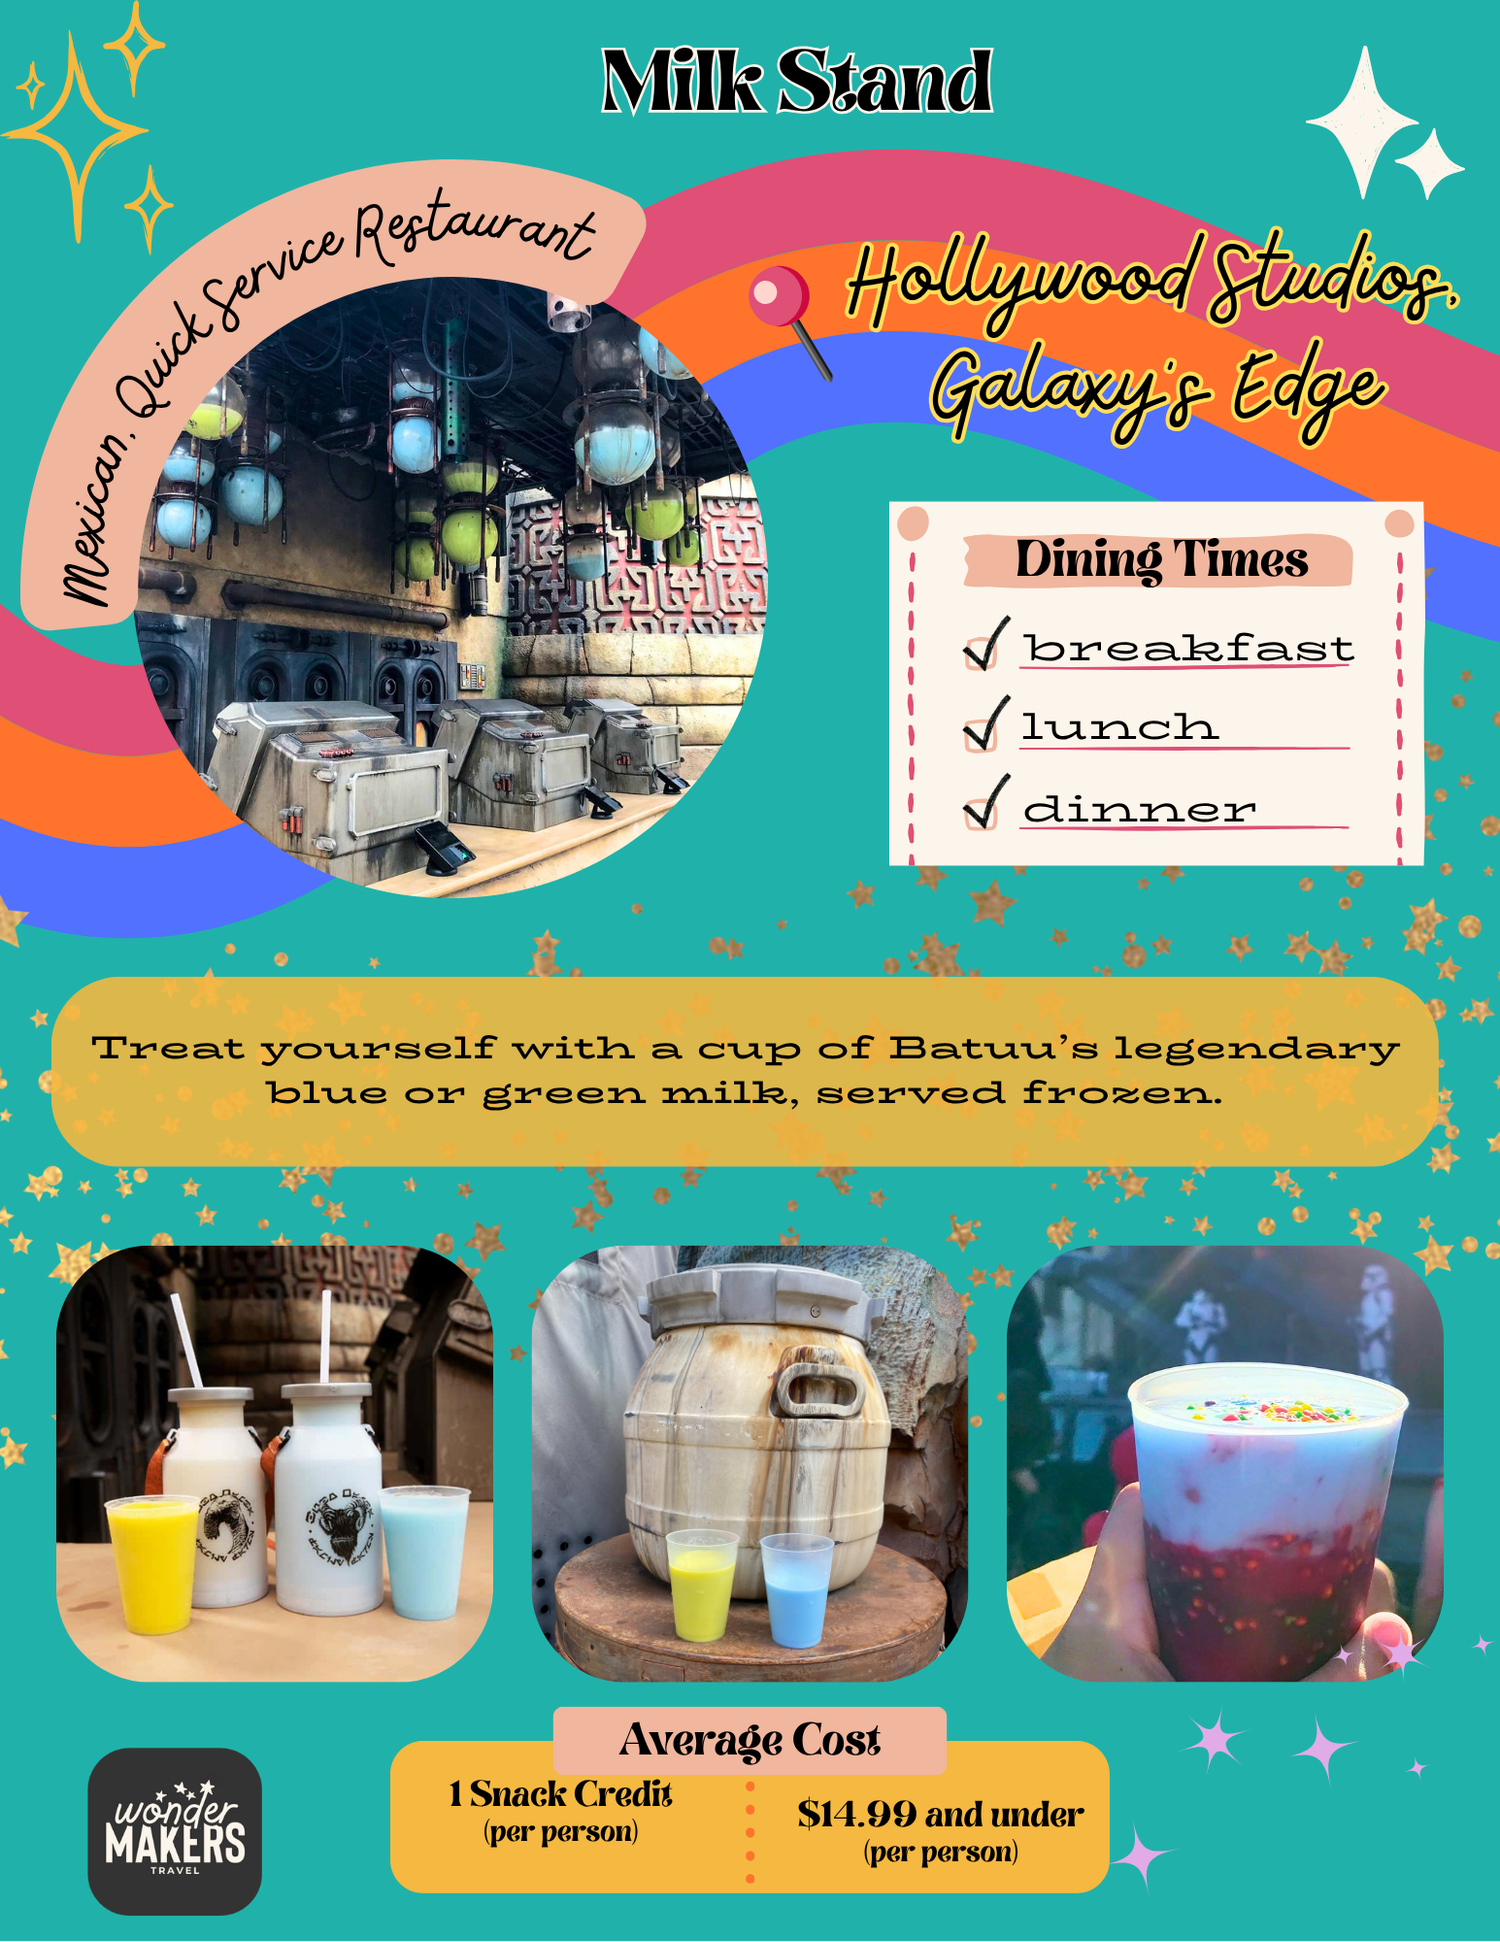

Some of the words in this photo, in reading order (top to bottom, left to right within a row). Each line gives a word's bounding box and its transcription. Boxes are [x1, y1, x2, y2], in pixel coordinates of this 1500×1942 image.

[602, 45, 764, 114] Milk
[777, 46, 993, 114] Stand
[846, 232, 1207, 341] Hollywood
[1207, 227, 1459, 327] Studios,
[62, 432, 137, 608] Mexican,
[115, 300, 214, 419] Quick
[202, 229, 345, 333] Service
[355, 186, 597, 268] Restaurant
[930, 339, 1214, 448] Galaxy's
[1232, 337, 1388, 449] Edge
[1017, 537, 1163, 588] Dining
[1173, 537, 1309, 578] Times
[1023, 632, 1355, 662] breakfast
[1022, 712, 1220, 740] lunch
[1024, 794, 1256, 823] dinner
[91, 1036, 245, 1060] Treat
[260, 1034, 498, 1067] yourself
[511, 1035, 636, 1060] with
[651, 1042, 683, 1060] a
[698, 1042, 801, 1066] cup
[818, 1034, 875, 1060] of
[889, 1033, 1098, 1060] Batuu’s
[1115, 1036, 1401, 1067] legendary
[265, 1080, 387, 1104] blue
[404, 1087, 465, 1104] or
[482, 1083, 647, 1111] green
[662, 1080, 799, 1110] milk,
[817, 1080, 1007, 1104] served
[1023, 1079, 1222, 1104] frozen.
[618, 1721, 783, 1766] Average
[792, 1721, 881, 1756] Cost
[114, 1791, 239, 1829] wonder
[449, 1780, 462, 1807] 1
[470, 1779, 567, 1807] Snack
[574, 1779, 673, 1808] Credit
[798, 1799, 917, 1831] $14.99
[925, 1800, 983, 1828] and
[990, 1800, 1085, 1828] under
[105, 1821, 246, 1864] MAKERS
[483, 1819, 536, 1848] (per
[541, 1819, 638, 1848] person)
[863, 1839, 916, 1868] (per
[921, 1839, 1018, 1868] person)
[150, 1866, 200, 1875] TRAVEL
